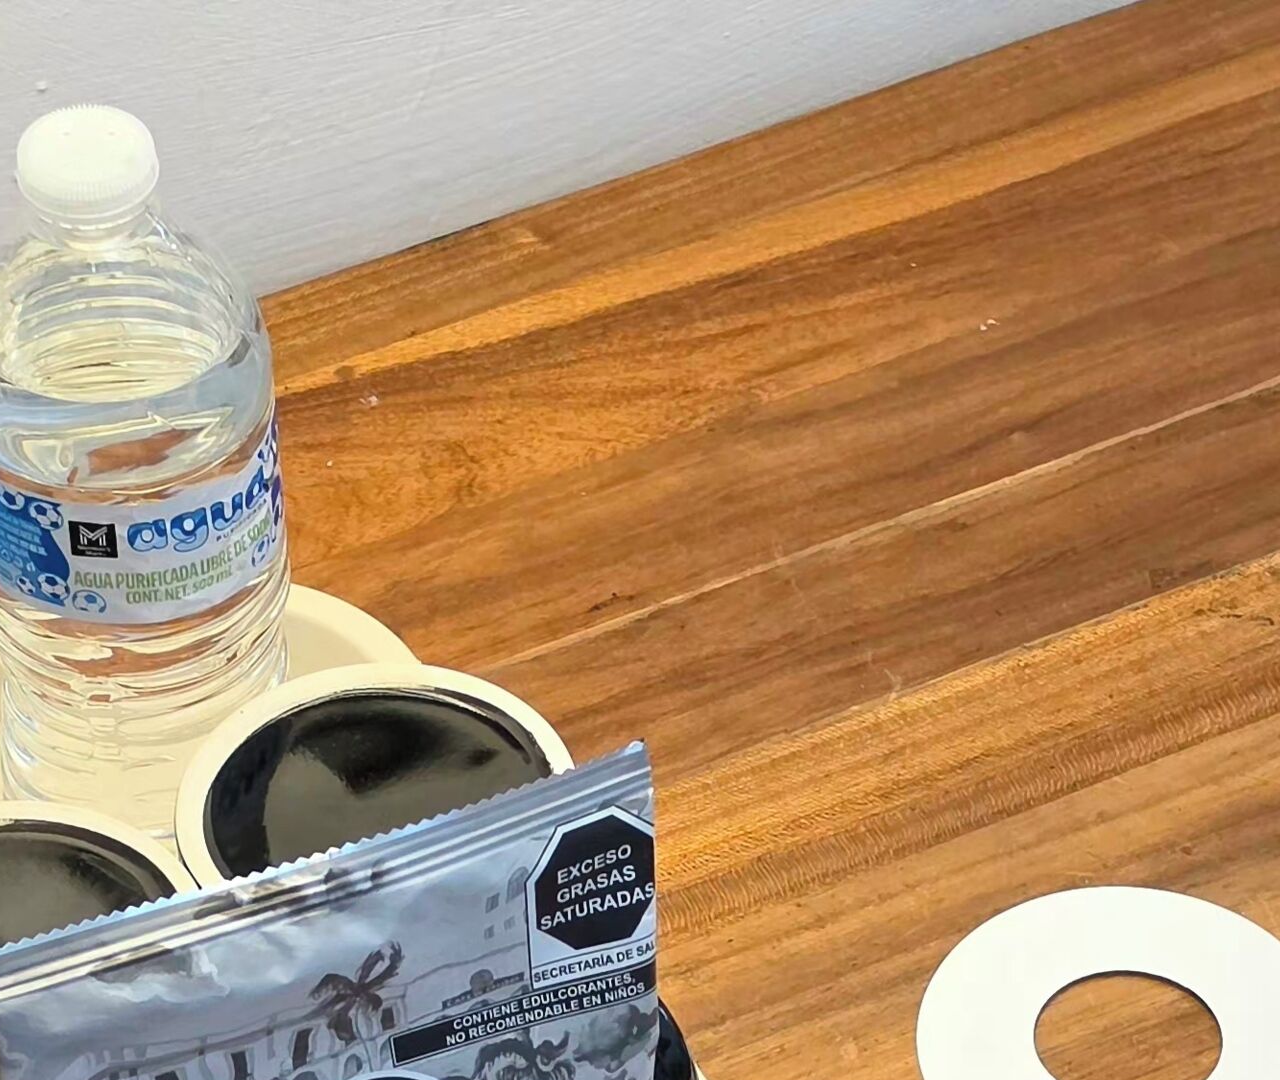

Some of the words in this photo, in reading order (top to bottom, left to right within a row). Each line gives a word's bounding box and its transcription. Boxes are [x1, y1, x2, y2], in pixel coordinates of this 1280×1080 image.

[127, 465, 267, 552] agua
[74, 571, 113, 589] AGUA
[116, 564, 198, 590] PURIFICADA
[201, 546, 233, 575] LIBRE
[234, 534, 248, 557] DE
[126, 589, 162, 604] CONT.
[165, 584, 191, 601] NET.
[193, 576, 214, 591] 500
[557, 845, 632, 885] EXCESO
[557, 865, 636, 904] GRASAS
[540, 882, 655, 931] SATURADAS
[533, 953, 614, 983] SECRETARÍA
[616, 948, 634, 963] DE
[446, 1031, 465, 1047] NO
[470, 999, 580, 1039] RECOMENDABLE
[583, 993, 602, 1008] EN
[604, 982, 646, 1002] NIÑOS
[453, 1002, 520, 1030] CONTIENE
[523, 973, 636, 1009] EDULCORANTES,
